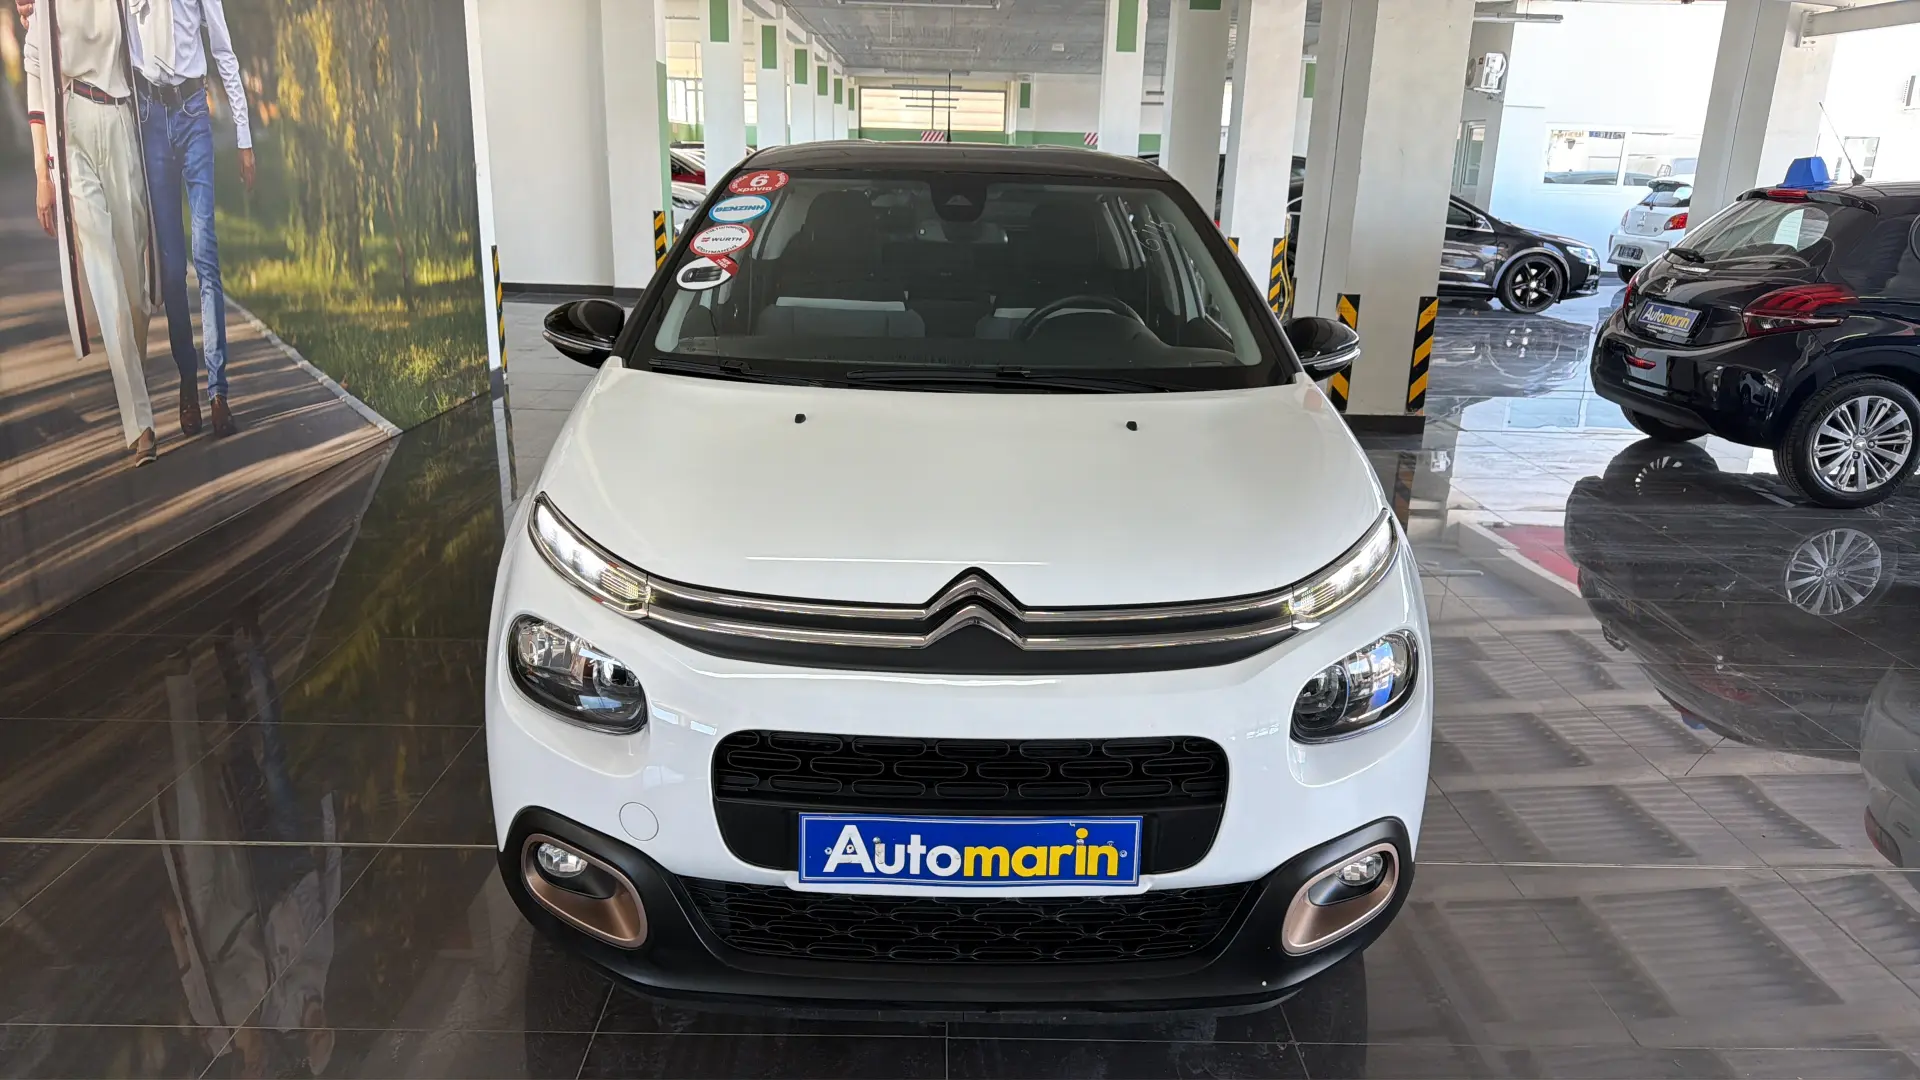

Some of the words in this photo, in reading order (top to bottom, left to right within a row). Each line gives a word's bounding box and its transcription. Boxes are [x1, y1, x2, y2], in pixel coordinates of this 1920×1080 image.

[750, 176, 770, 187] 6
[1642, 305, 1690, 328] Automarin
[822, 824, 1119, 877] Automarin
